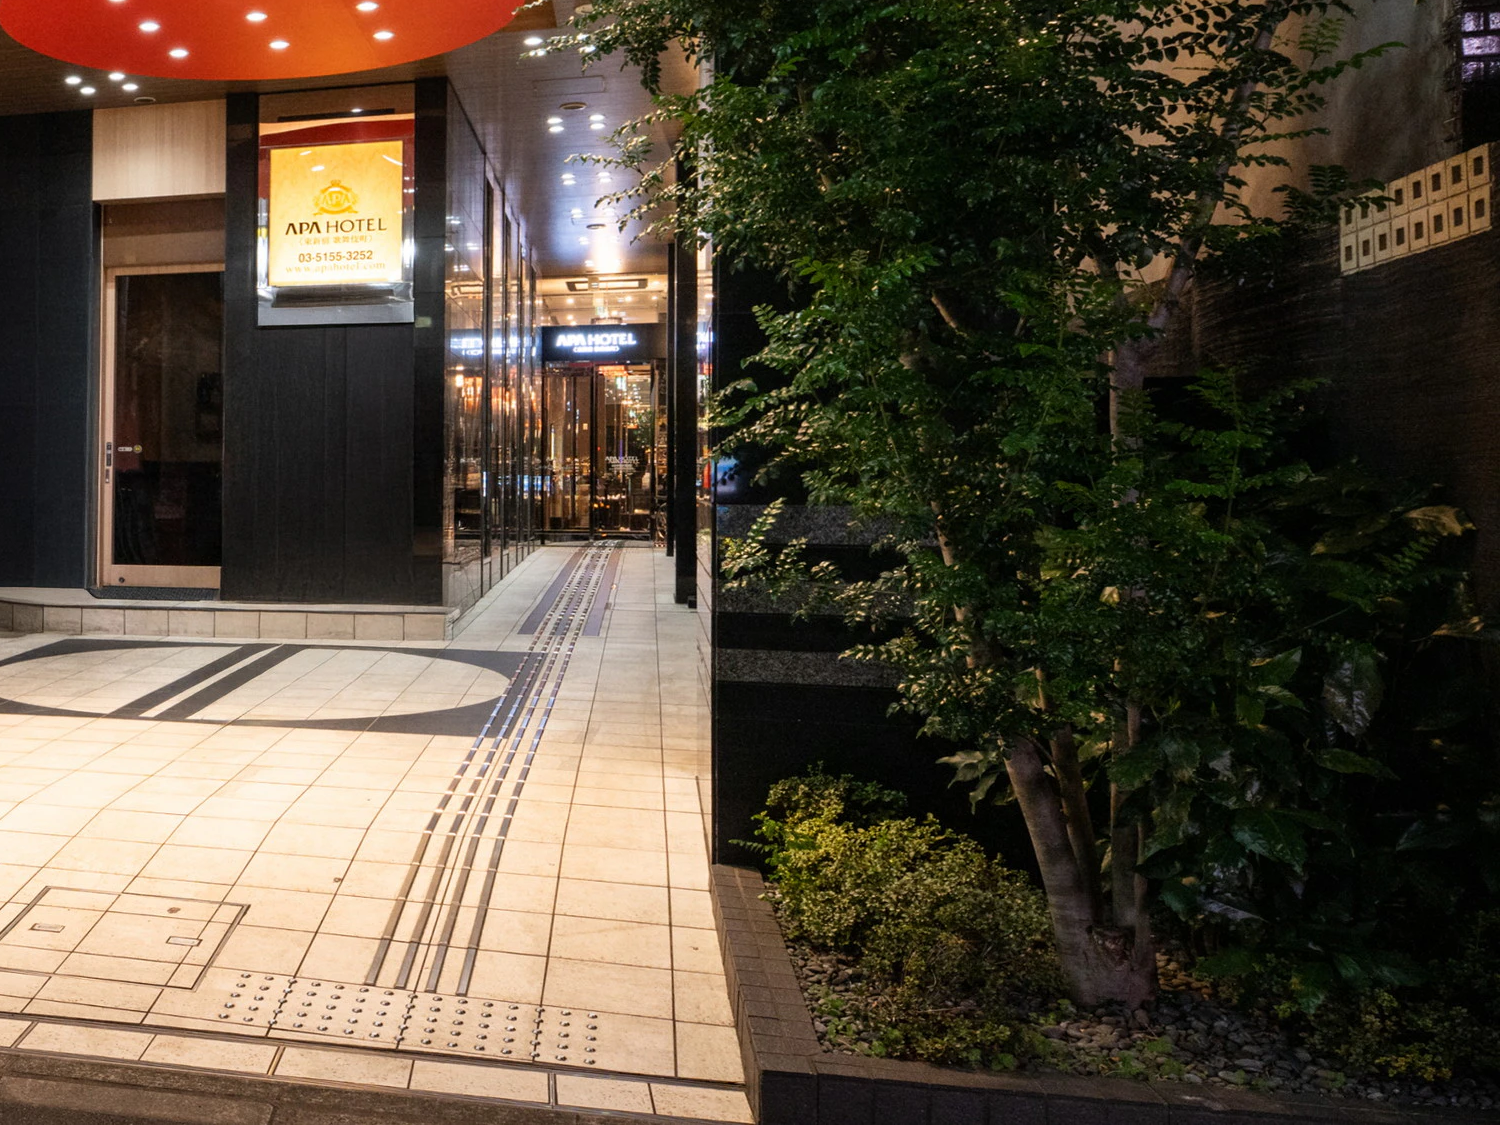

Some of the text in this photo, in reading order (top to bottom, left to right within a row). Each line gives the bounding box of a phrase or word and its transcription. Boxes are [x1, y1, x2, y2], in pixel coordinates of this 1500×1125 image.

[285, 218, 387, 235] APA HOTEL
[298, 250, 373, 263] 03-5155-3252
[285, 262, 386, 273] www.apahotel.com
[556, 333, 587, 347] APA
[587, 333, 637, 346] HOTEL
